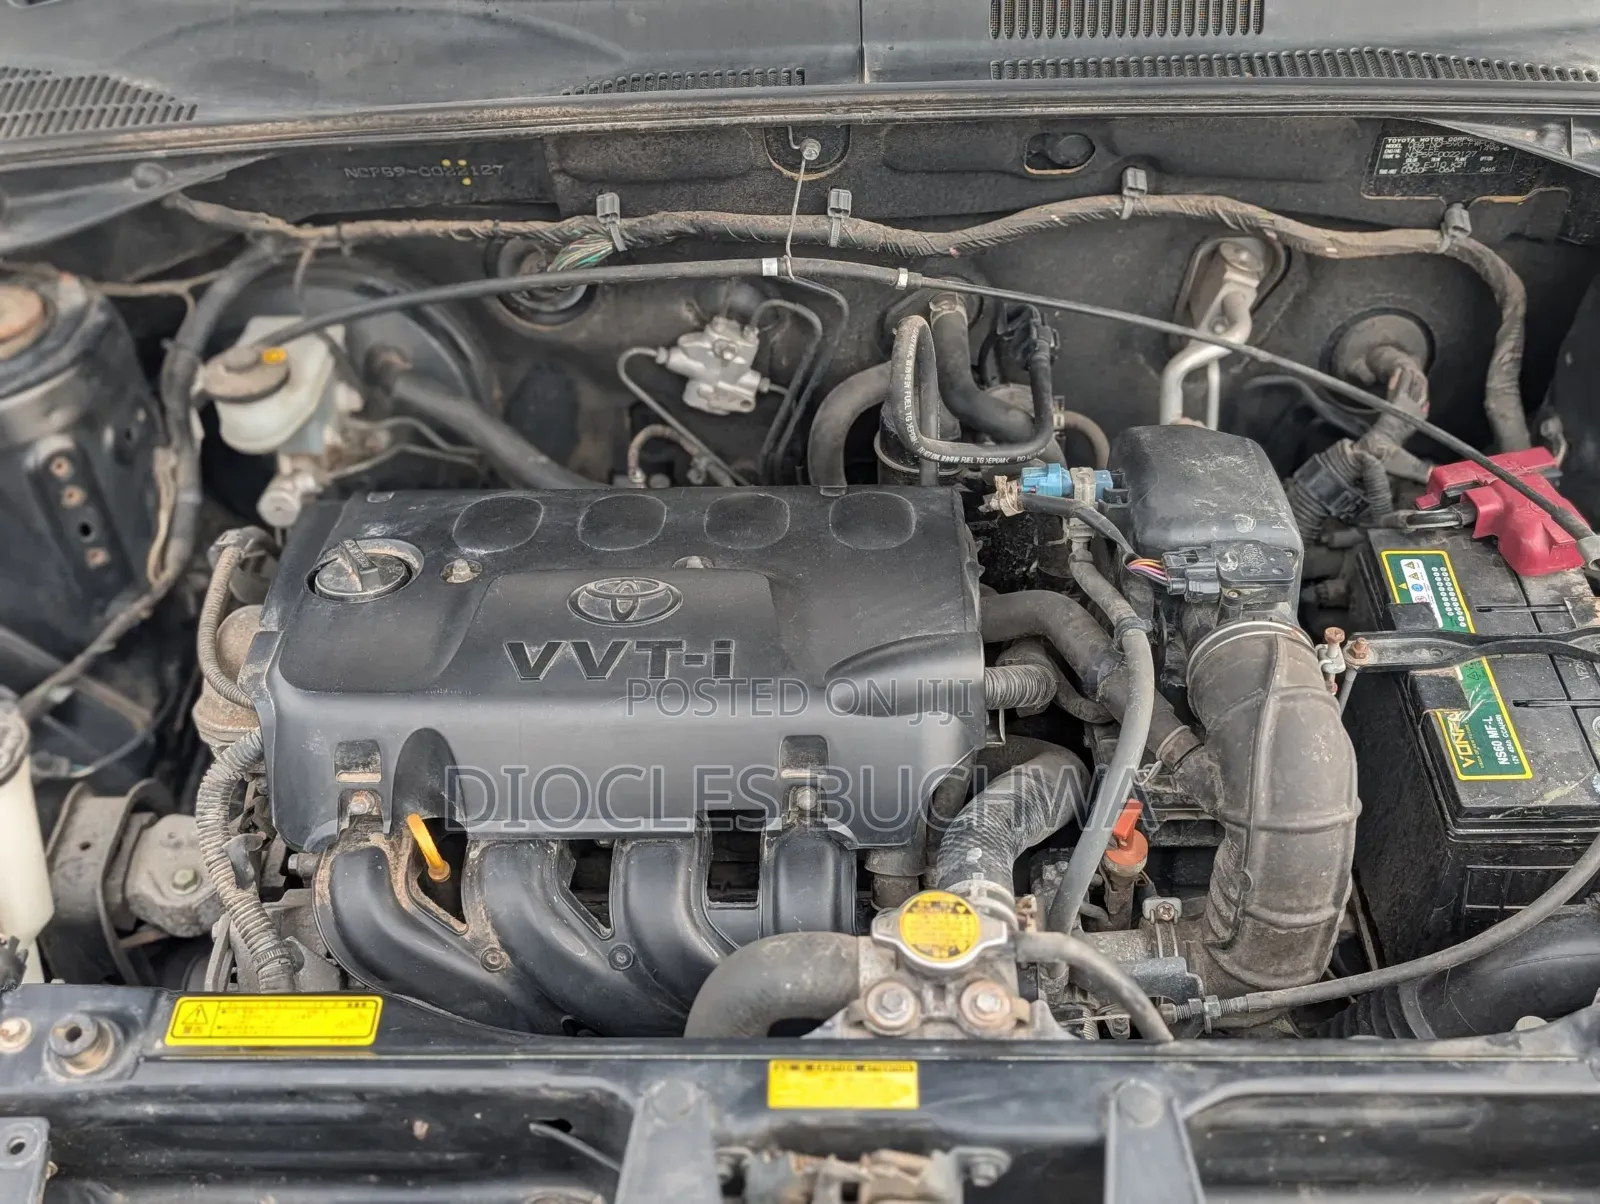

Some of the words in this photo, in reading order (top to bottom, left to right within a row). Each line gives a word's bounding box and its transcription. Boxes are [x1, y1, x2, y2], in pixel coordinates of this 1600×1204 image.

[904, 390, 912, 410] FUEL
[504, 639, 736, 681] VVT-i
[1482, 715, 1500, 738] MF-L
[1491, 741, 1511, 765] NS60
